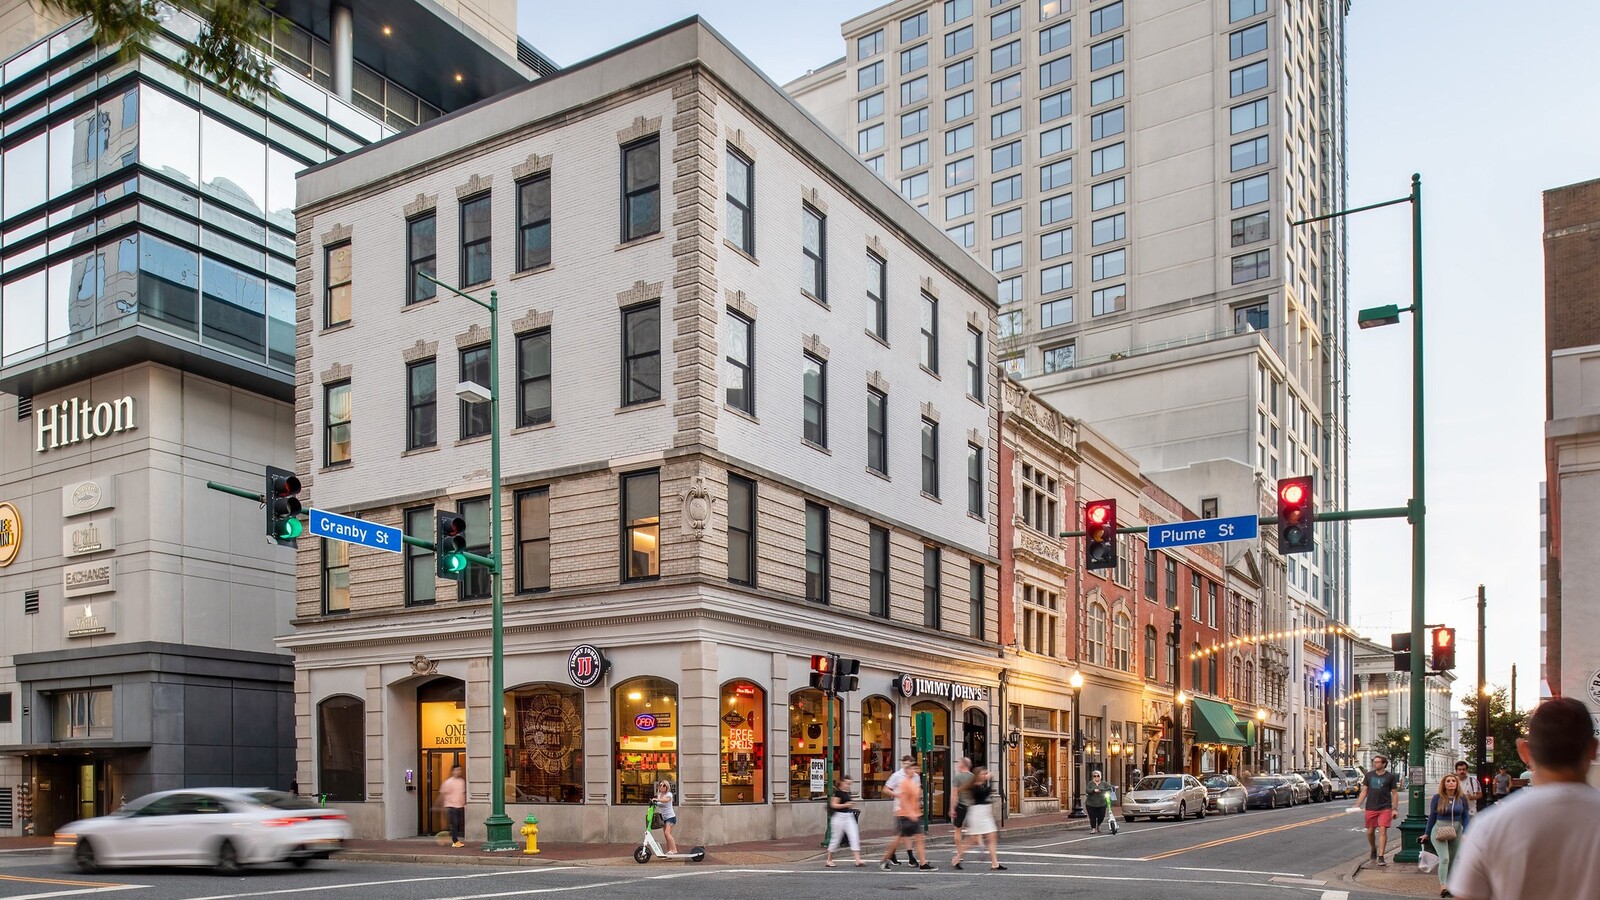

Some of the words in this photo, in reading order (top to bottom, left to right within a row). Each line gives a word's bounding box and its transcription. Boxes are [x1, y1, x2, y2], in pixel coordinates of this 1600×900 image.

[36, 396, 135, 452] Hilton
[320, 517, 367, 542] Granby
[375, 530, 389, 545] St
[1161, 529, 1206, 543] Plume
[1218, 523, 1234, 537] St
[66, 566, 110, 585] EXCHANGE
[577, 657, 591, 676] JJ
[915, 679, 950, 697] JIMMY
[951, 683, 982, 701] JOHN'S
[635, 717, 655, 727] OPEN
[445, 724, 466, 737] ONE
[729, 728, 755, 741] FREE
[435, 736, 453, 745] EAST
[729, 740, 754, 750] SMELLS
[811, 761, 824, 770] OPEN
